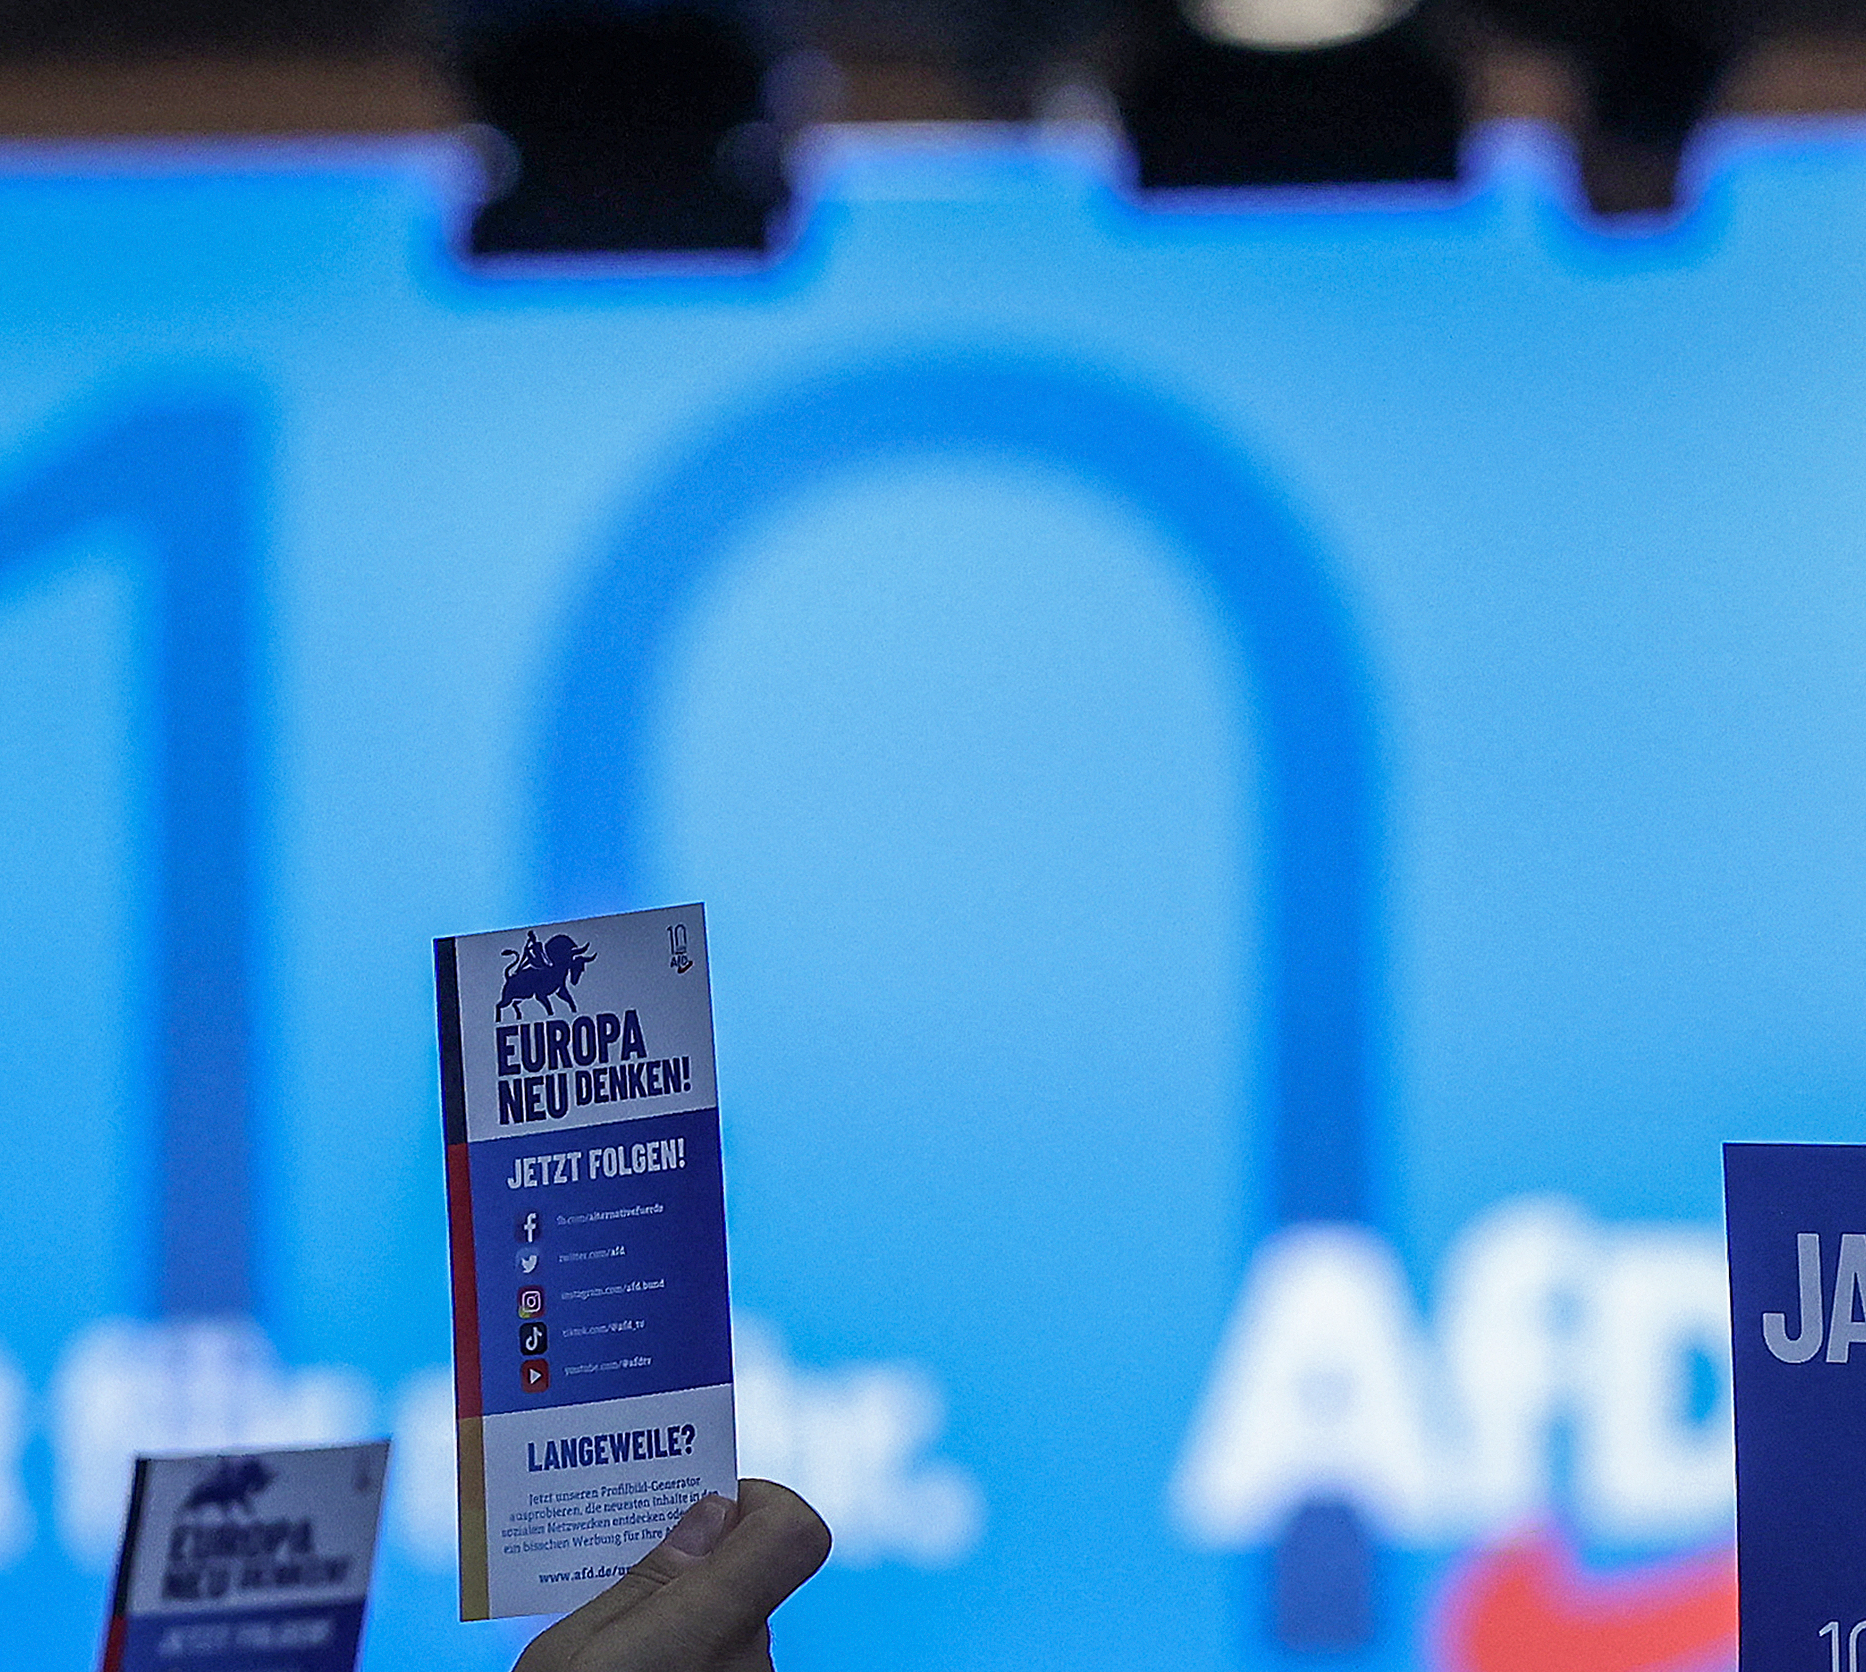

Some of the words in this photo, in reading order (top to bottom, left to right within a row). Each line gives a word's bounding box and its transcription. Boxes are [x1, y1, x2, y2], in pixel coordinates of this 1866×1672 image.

[496, 1009, 647, 1076] EUROPA
[499, 1072, 569, 1125] NEU
[576, 1055, 691, 1107] DENKEN!
[507, 1151, 582, 1190] JETZT
[590, 1137, 686, 1179] FOLGEN!
[1173, 1200, 1737, 1549] AfD
[527, 1424, 695, 1472] LANGEWEILE?
[573, 1531, 621, 1548] Werbung
